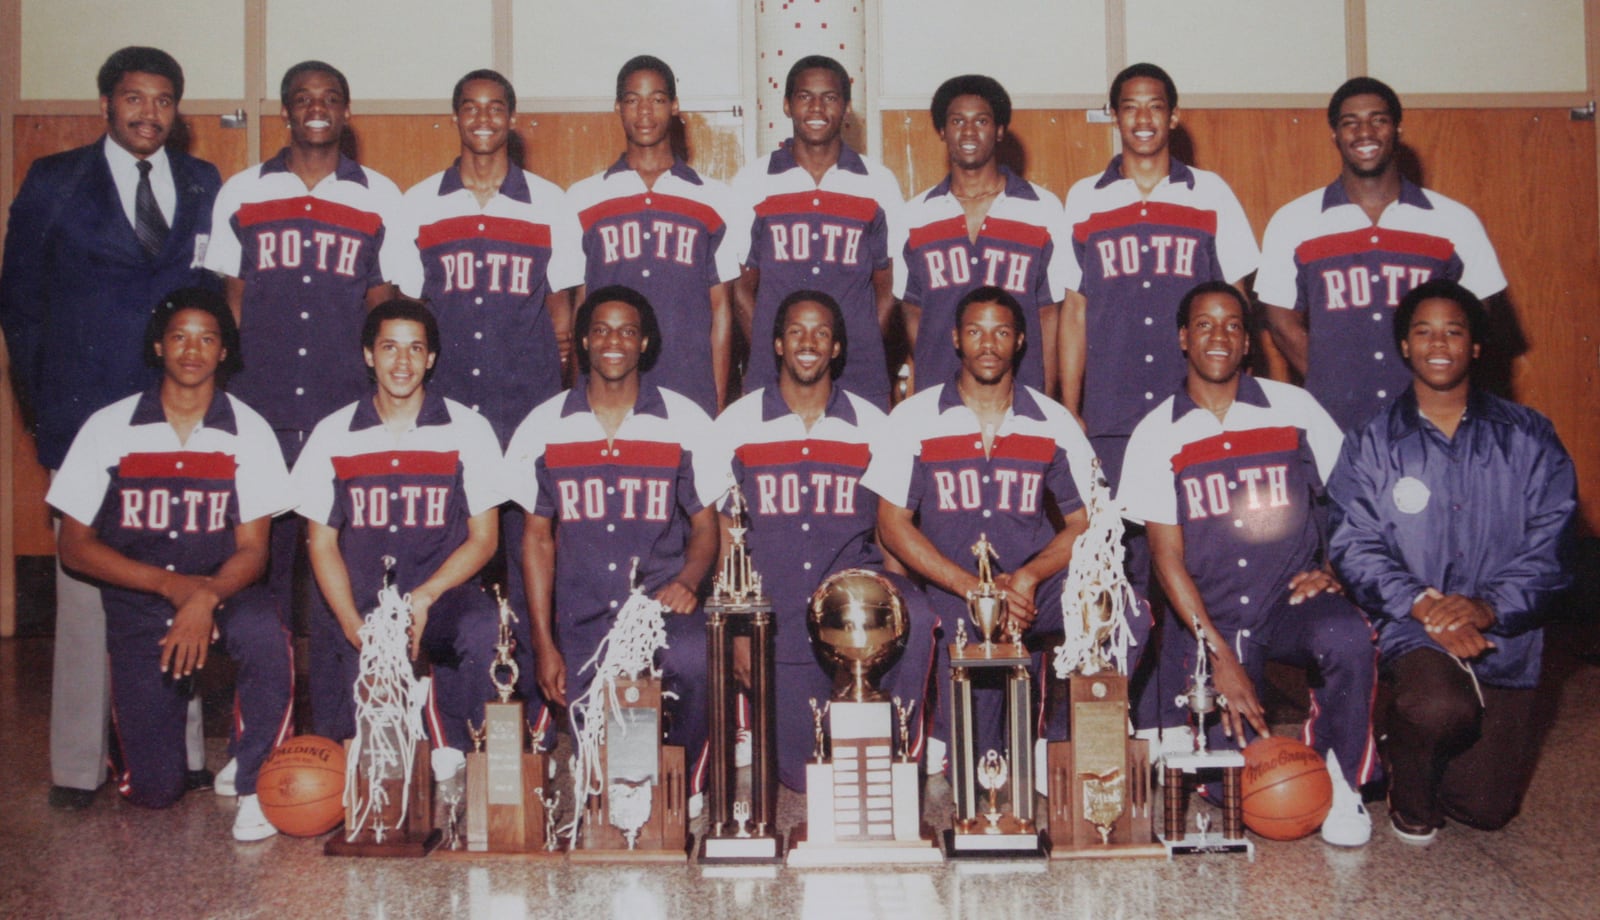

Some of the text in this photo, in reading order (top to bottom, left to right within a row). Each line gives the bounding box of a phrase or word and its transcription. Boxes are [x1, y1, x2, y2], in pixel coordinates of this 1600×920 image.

[257, 229, 361, 277] ROTH
[599, 220, 698, 265] ROTH
[769, 222, 863, 265] ROTH
[1097, 235, 1197, 278] ROTH
[923, 245, 1031, 293] ROTH
[120, 488, 230, 532] ROTH
[349, 485, 449, 527] ROTH
[557, 477, 671, 522] ROTH
[756, 472, 858, 515] ROTH
[934, 469, 1042, 514] ROTH
[1183, 465, 1290, 521] ROTH
